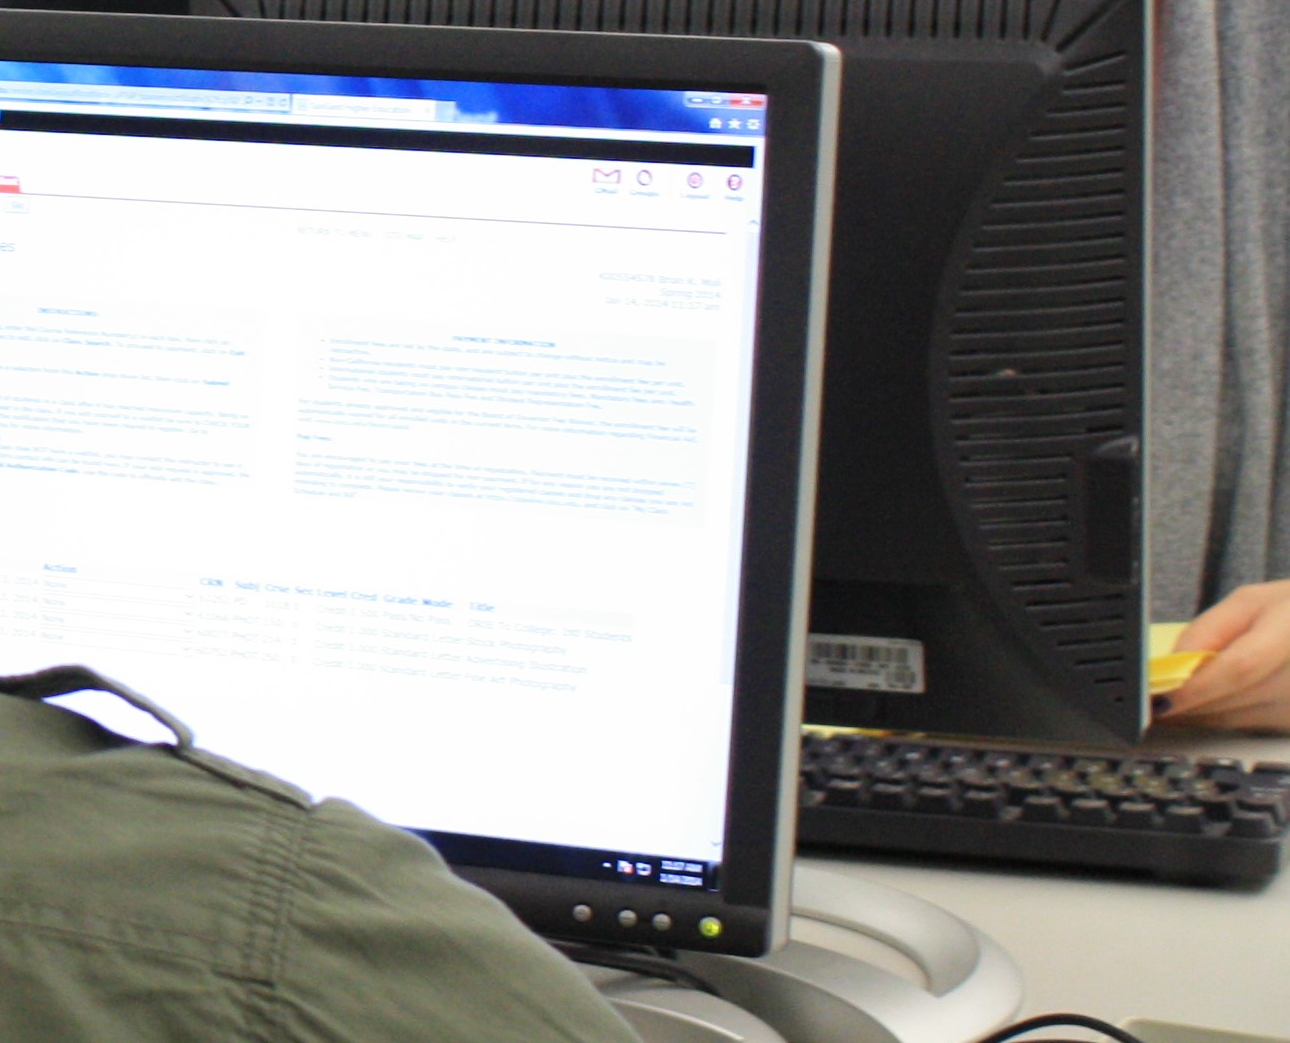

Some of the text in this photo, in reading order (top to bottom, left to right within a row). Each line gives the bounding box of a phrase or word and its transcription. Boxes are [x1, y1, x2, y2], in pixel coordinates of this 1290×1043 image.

[42, 562, 78, 574] Action
[499, 639, 567, 656] Photography
[508, 675, 578, 693] Photography
